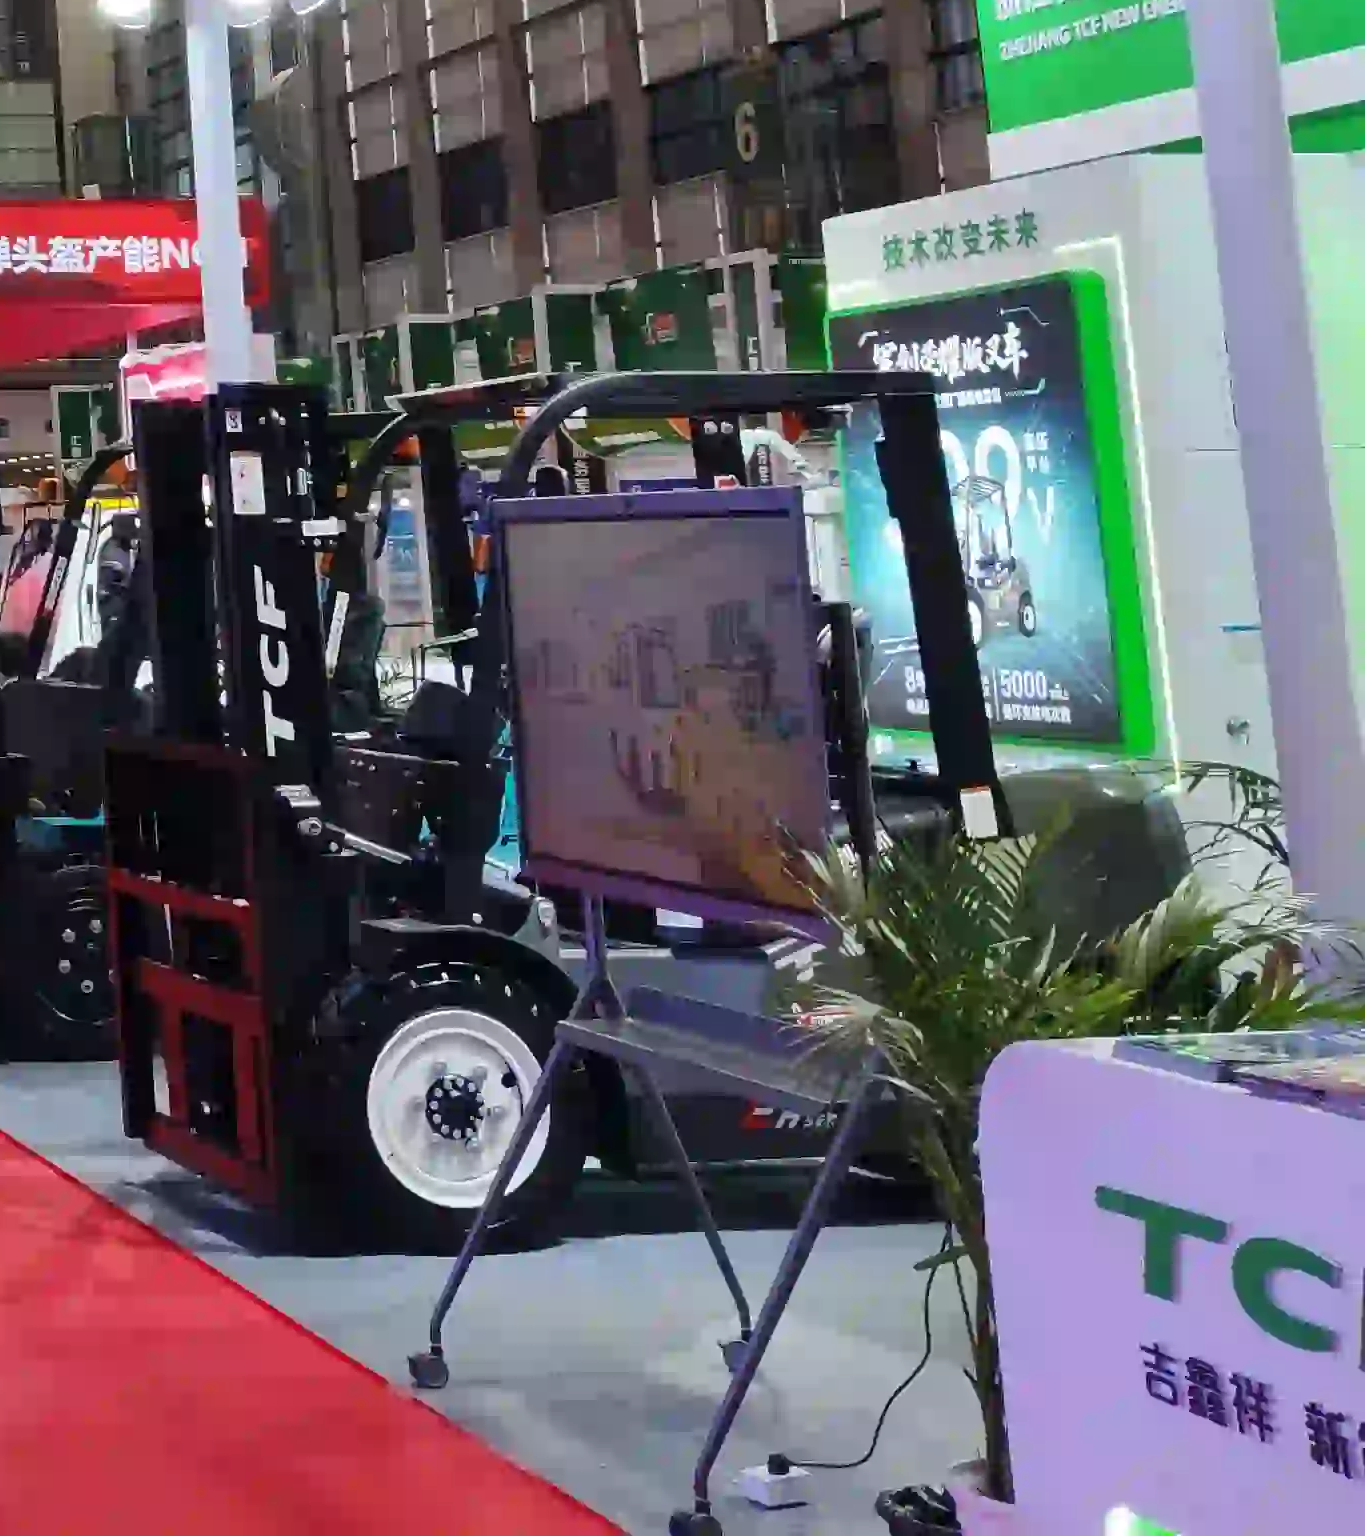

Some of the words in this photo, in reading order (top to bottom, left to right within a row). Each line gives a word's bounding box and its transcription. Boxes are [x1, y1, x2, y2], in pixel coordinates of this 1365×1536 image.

[734, 101, 759, 162] 6
[882, 207, 1039, 272] 技术改变未来
[253, 563, 297, 758] TCF
[1000, 669, 1048, 700] 5000
[1094, 1185, 1365, 1372] TC
[1138, 1340, 1276, 1443] 吉鑫祥
